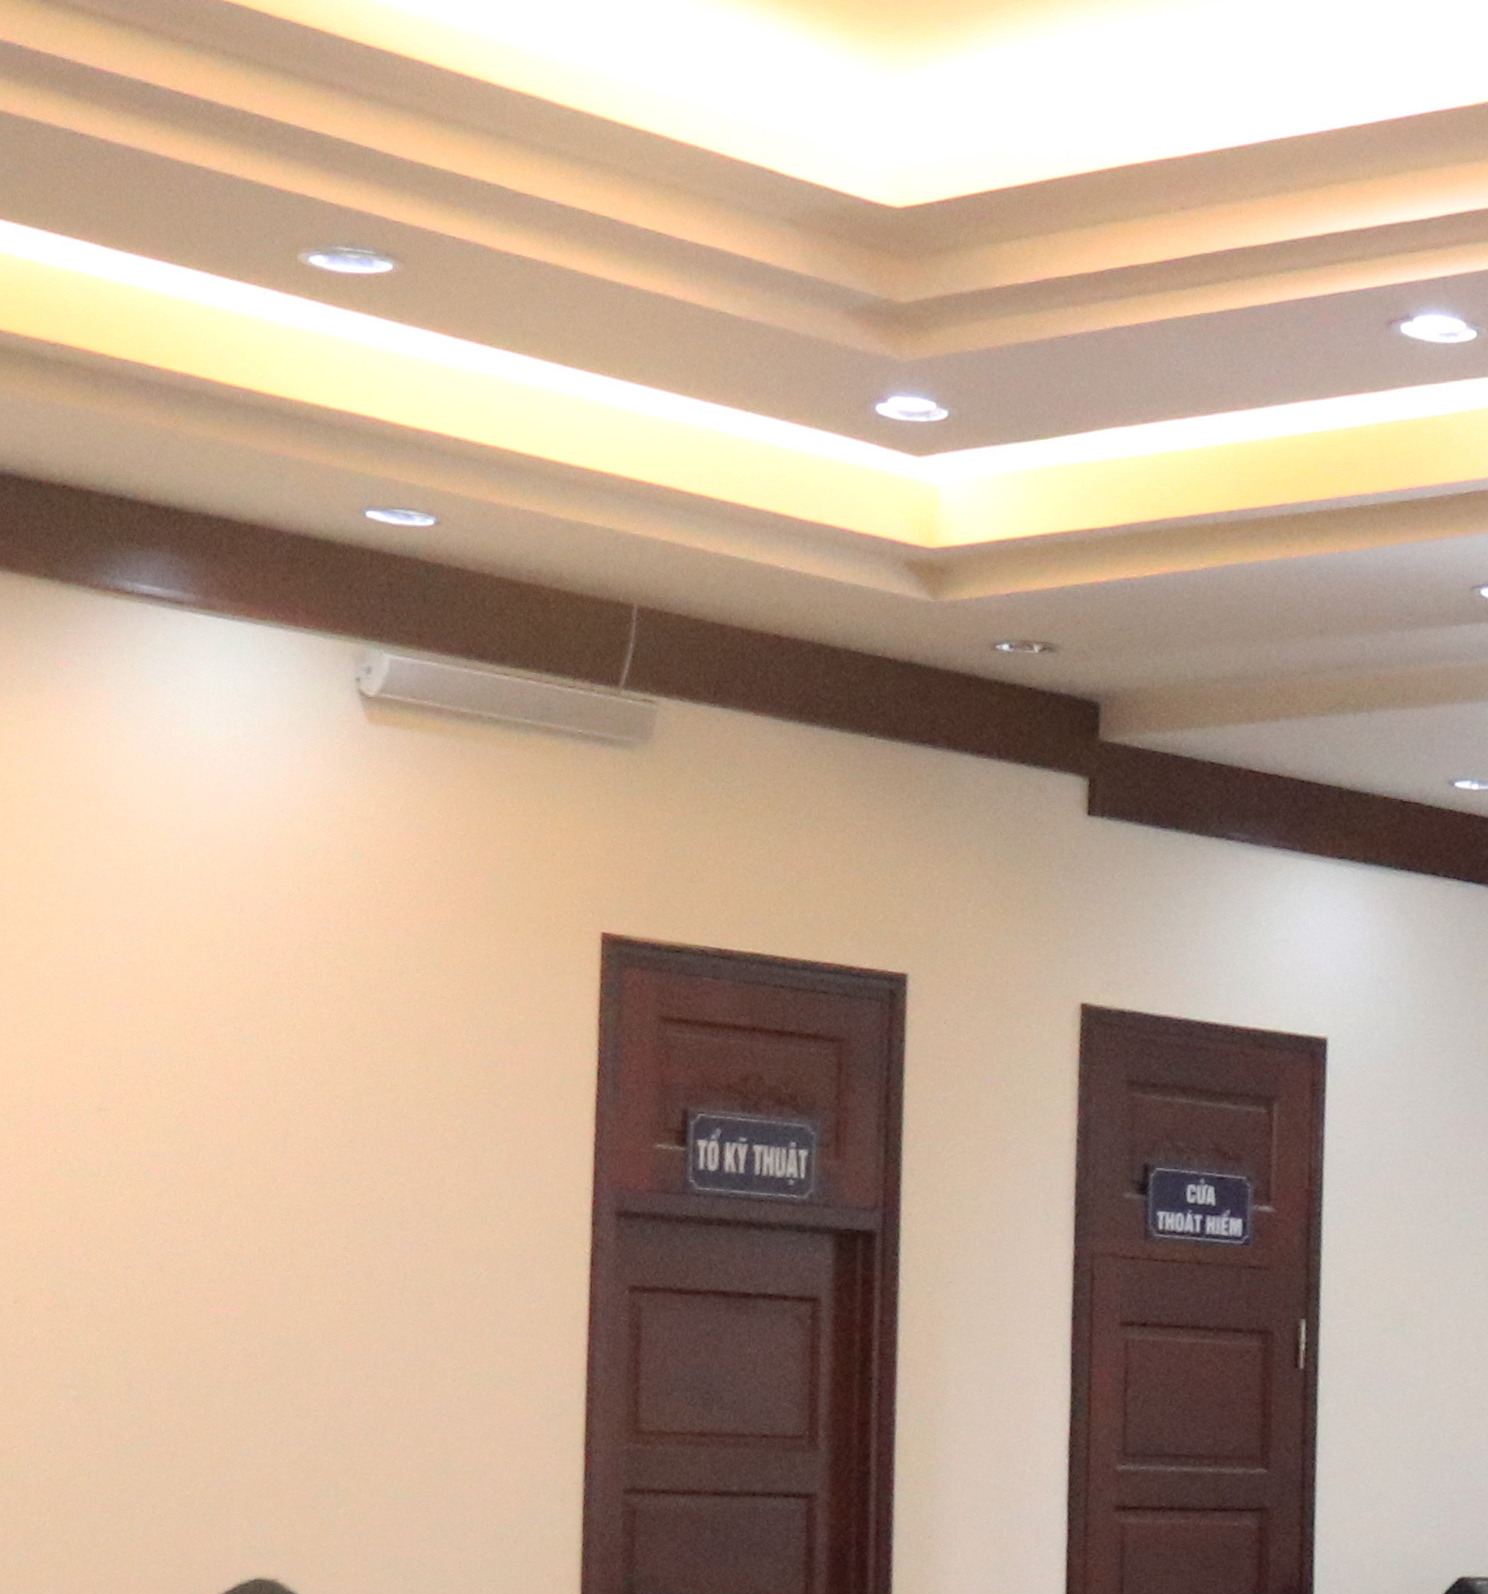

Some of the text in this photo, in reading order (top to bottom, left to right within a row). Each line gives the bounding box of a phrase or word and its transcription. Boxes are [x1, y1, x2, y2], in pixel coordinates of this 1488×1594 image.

[753, 1141, 809, 1186] THUẬT
[1186, 1178, 1216, 1206] CỬA
[1156, 1209, 1203, 1233] THOÁT
